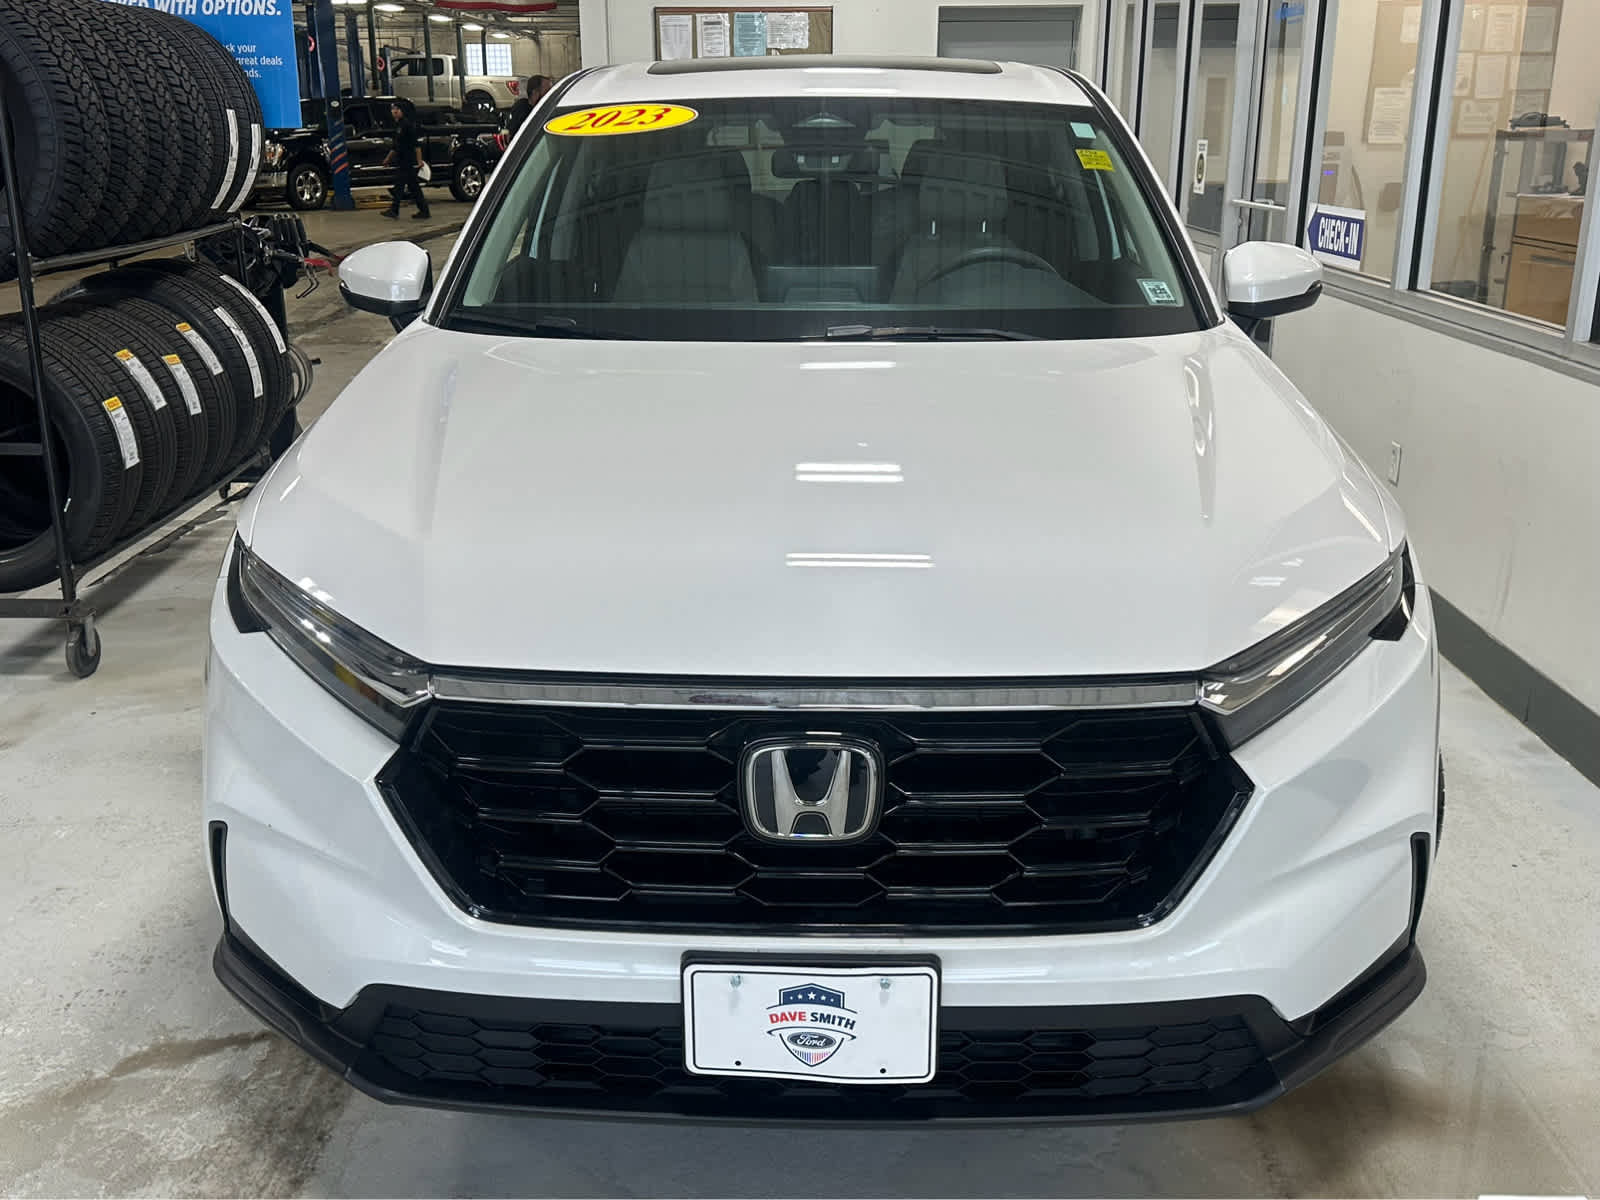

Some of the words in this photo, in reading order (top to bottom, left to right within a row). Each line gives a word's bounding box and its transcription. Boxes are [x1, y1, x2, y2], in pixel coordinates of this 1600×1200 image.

[153, 0, 197, 16] WITH
[201, 0, 282, 16] OPTIONS.
[222, 43, 236, 53] sk
[237, 44, 257, 54] your
[260, 55, 283, 66] deals
[564, 107, 672, 131] 2023
[1318, 216, 1360, 256] CHECK-IN
[769, 1011, 807, 1024] DAVE
[809, 1012, 856, 1030] SMITH
[796, 1033, 826, 1047] Ford
